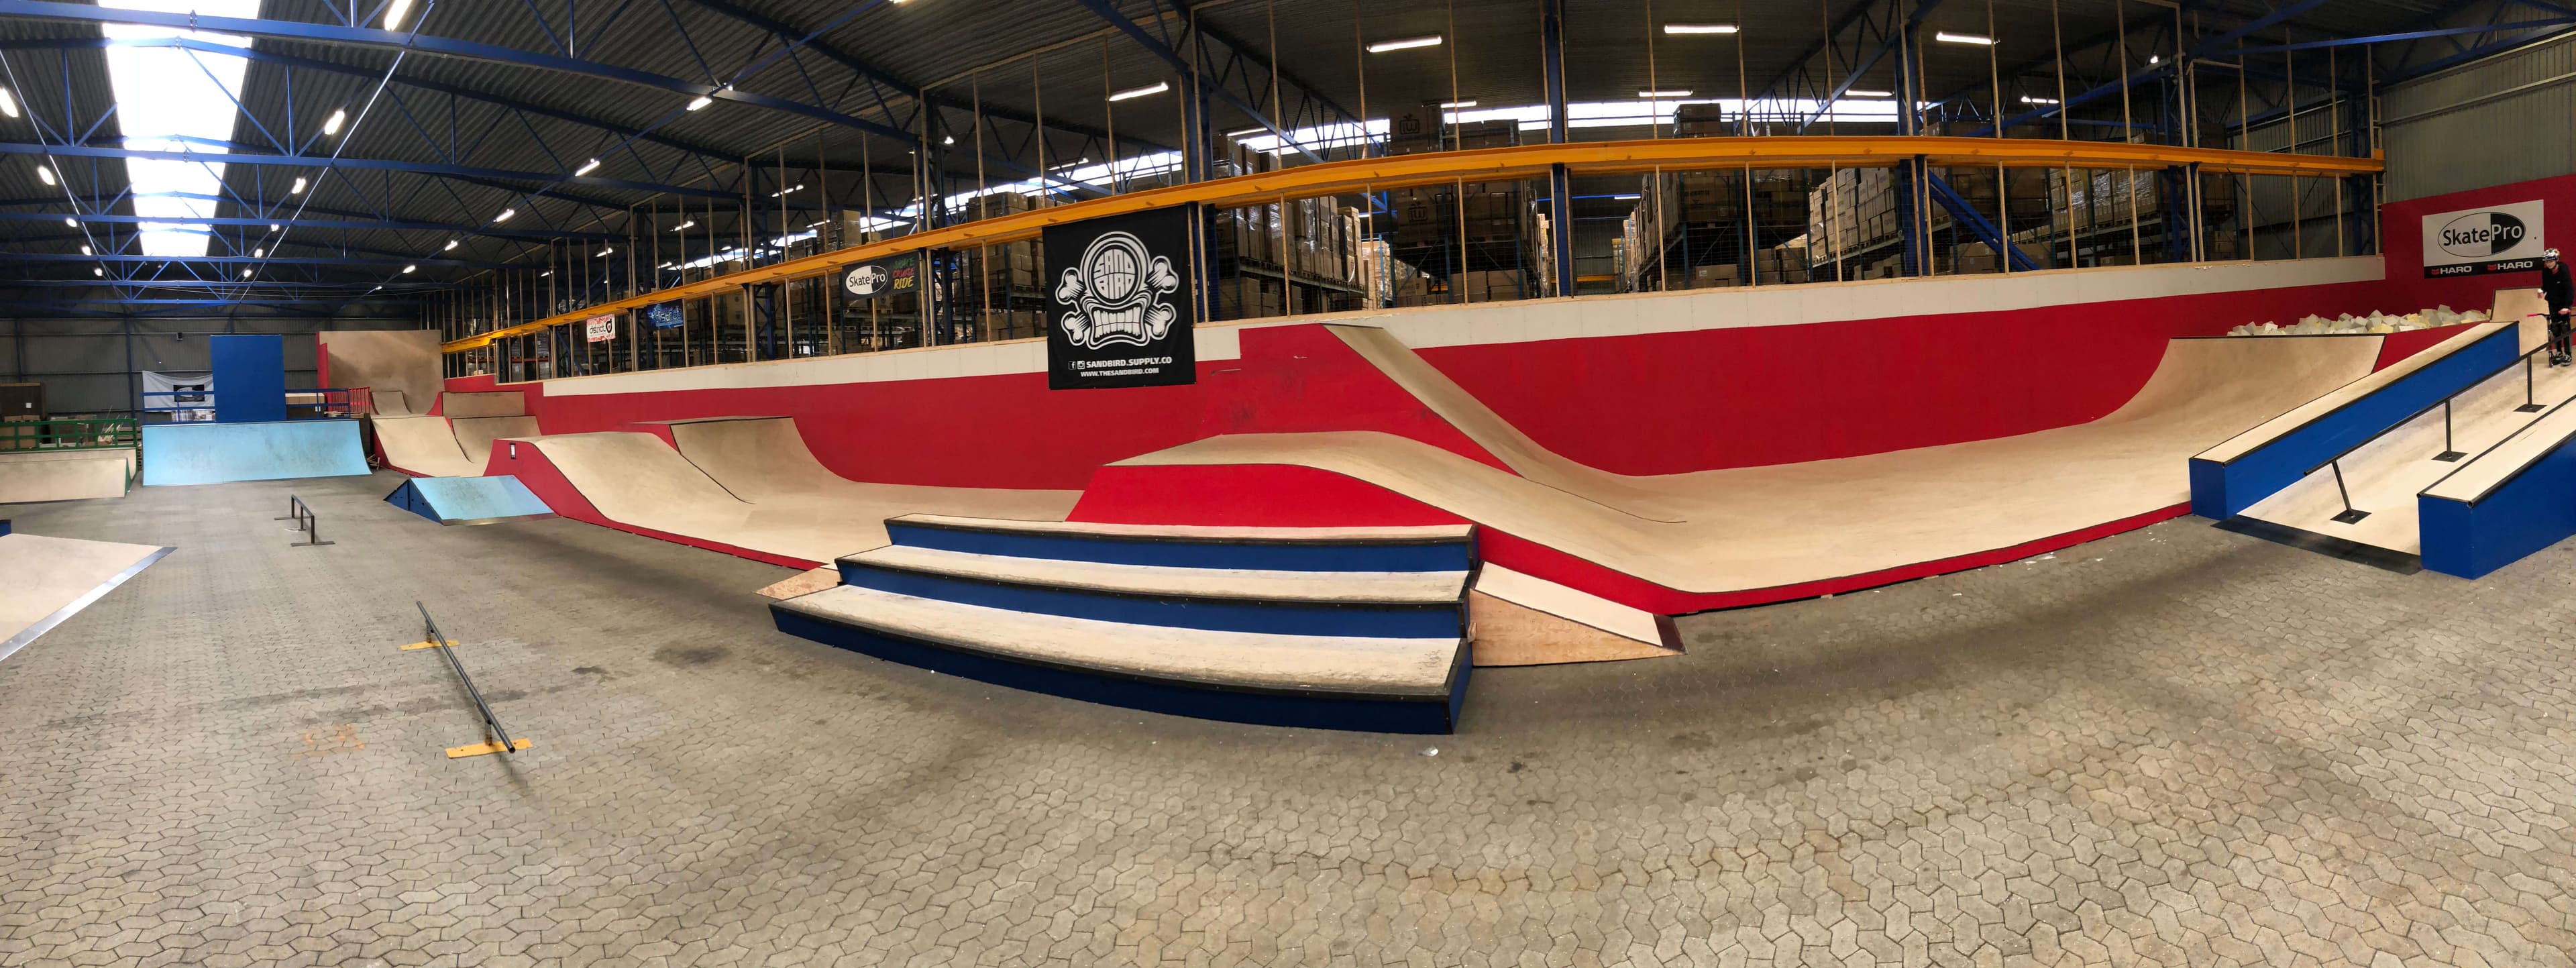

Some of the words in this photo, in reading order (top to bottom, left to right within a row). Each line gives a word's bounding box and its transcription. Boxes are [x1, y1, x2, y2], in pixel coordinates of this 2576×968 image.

[2443, 224, 2522, 246] SkatePro
[1093, 248, 1136, 274] SAND
[2497, 261, 2533, 270] HARO
[2440, 266, 2472, 274] HARO
[849, 273, 885, 287] SkatePro
[894, 276, 914, 289] RIDE
[1093, 272, 1136, 300] BIRD
[1086, 356, 1172, 368] SANDBIRD.SUPPLY.CO
[1080, 368, 1159, 377] WWW.THESANDBIRD.COM
